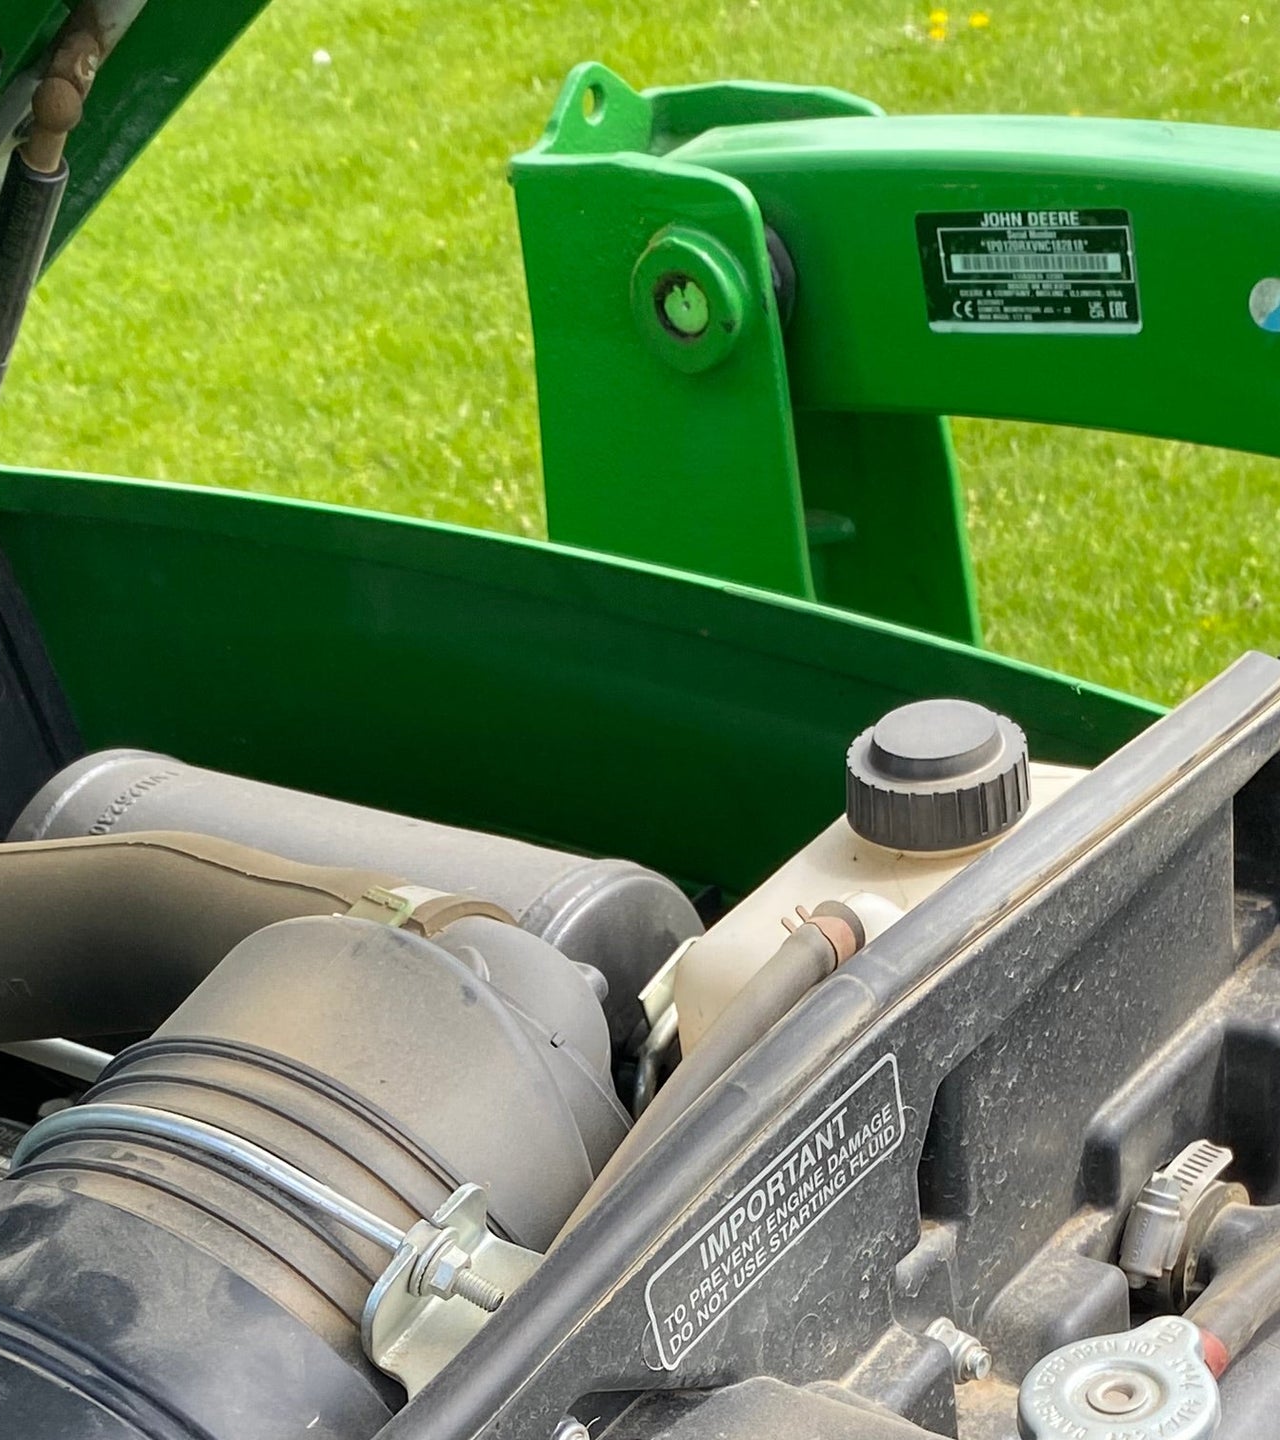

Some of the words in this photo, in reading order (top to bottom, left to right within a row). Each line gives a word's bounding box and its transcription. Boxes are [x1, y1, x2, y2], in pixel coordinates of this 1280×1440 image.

[981, 212, 1023, 228] JOHN
[1027, 210, 1080, 227] DEERE
[664, 1304, 687, 1333] TO
[690, 1224, 770, 1305] PREVENT
[766, 1168, 825, 1235] ENGINE
[826, 1103, 894, 1174] DAMAGE
[668, 1322, 693, 1356] DO
[697, 1283, 737, 1328] NOT
[732, 1252, 767, 1289] USE
[768, 1170, 848, 1258] STARTING
[848, 1126, 896, 1178] FLUID
[698, 1107, 849, 1271] IMPORTANT
